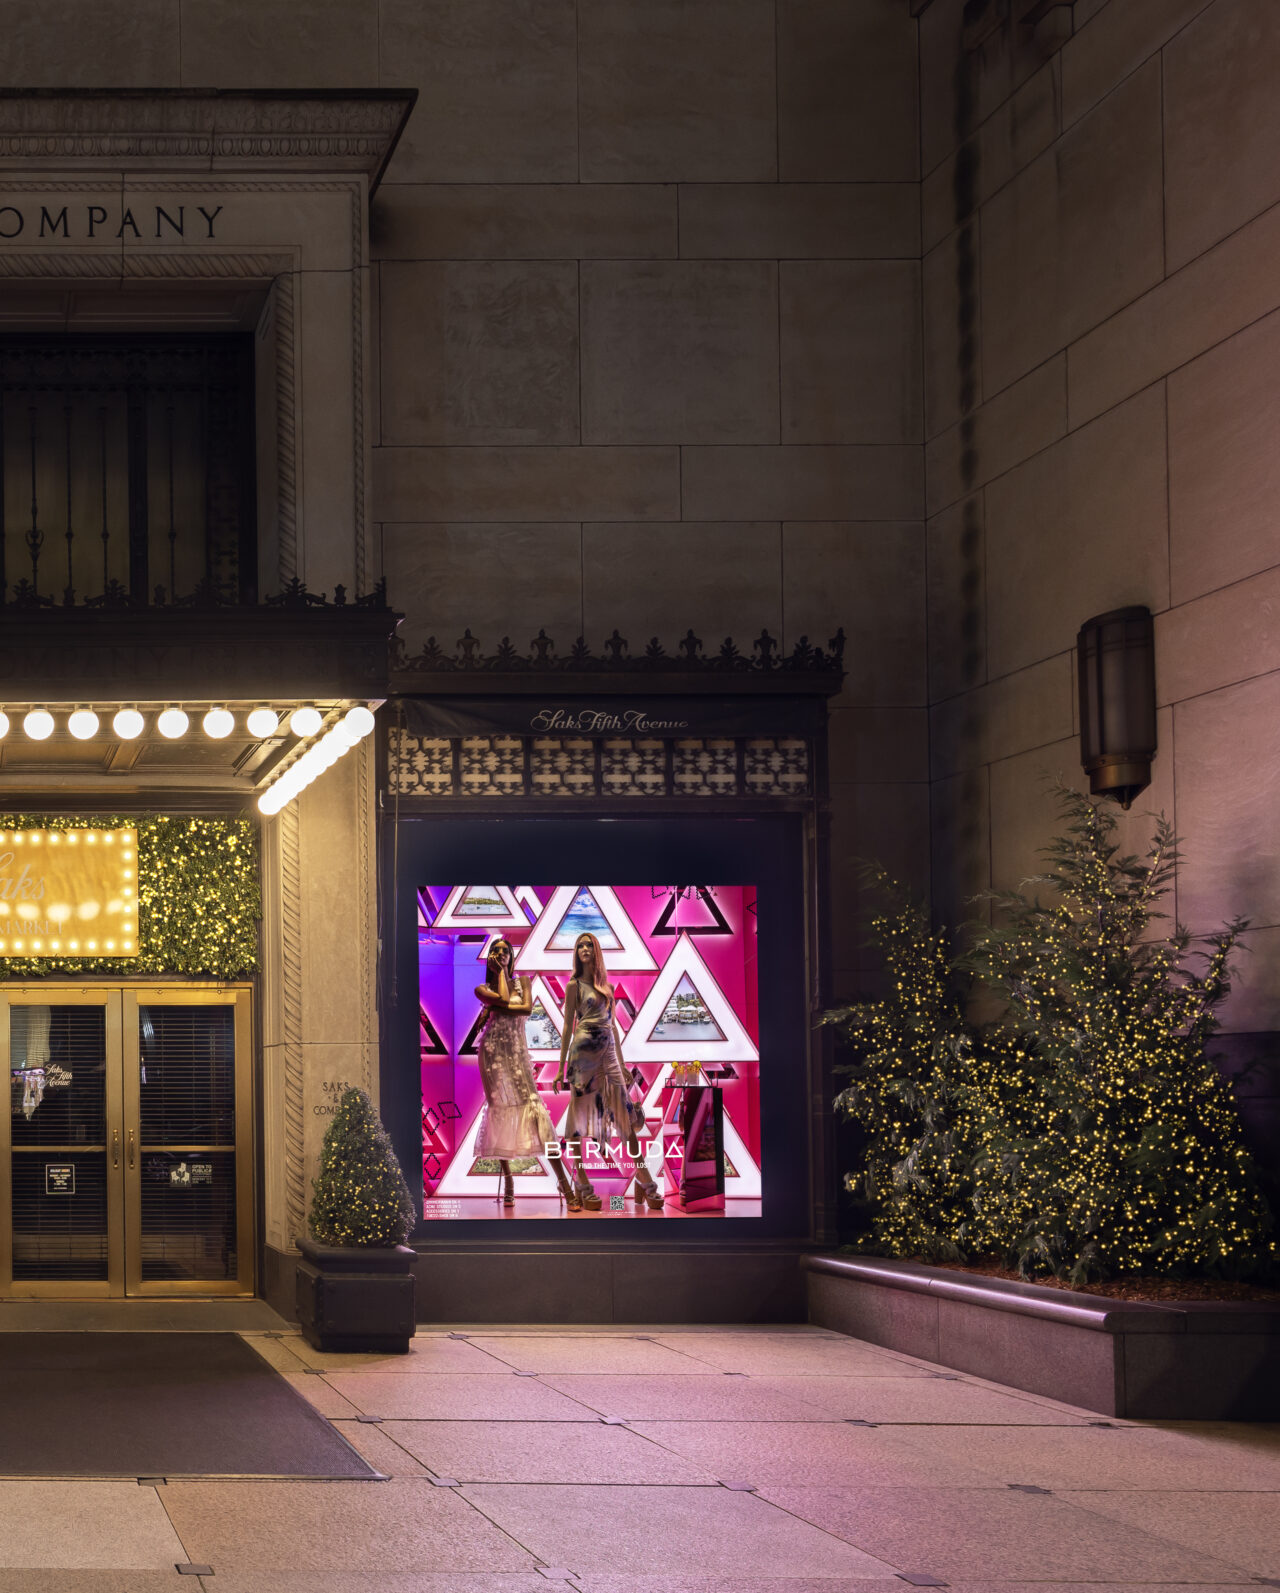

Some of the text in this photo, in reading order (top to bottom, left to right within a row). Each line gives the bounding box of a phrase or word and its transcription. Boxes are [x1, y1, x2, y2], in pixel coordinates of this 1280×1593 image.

[530, 709, 689, 733] Saks Fifth Avenue
[322, 1082, 350, 1092] SAKS
[544, 1140, 684, 1159] BERMUDA
